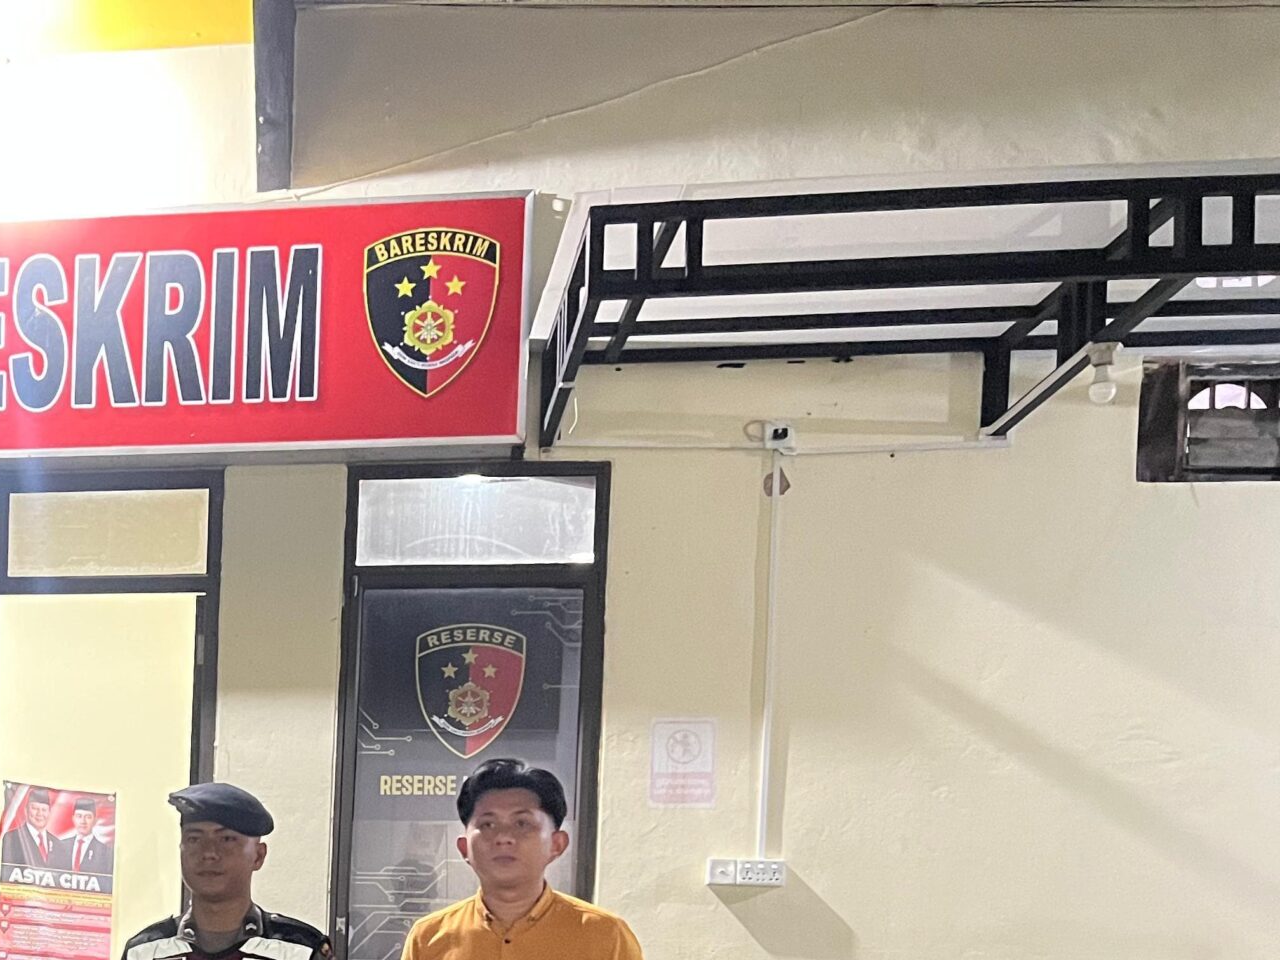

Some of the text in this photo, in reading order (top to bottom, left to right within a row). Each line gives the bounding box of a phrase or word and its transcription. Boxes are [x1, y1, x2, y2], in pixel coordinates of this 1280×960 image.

[375, 231, 490, 262] BARESKRIM
[427, 628, 517, 648] RESERSE
[380, 774, 457, 796] RESERSE
[9, 867, 101, 892] ASTA CITA
